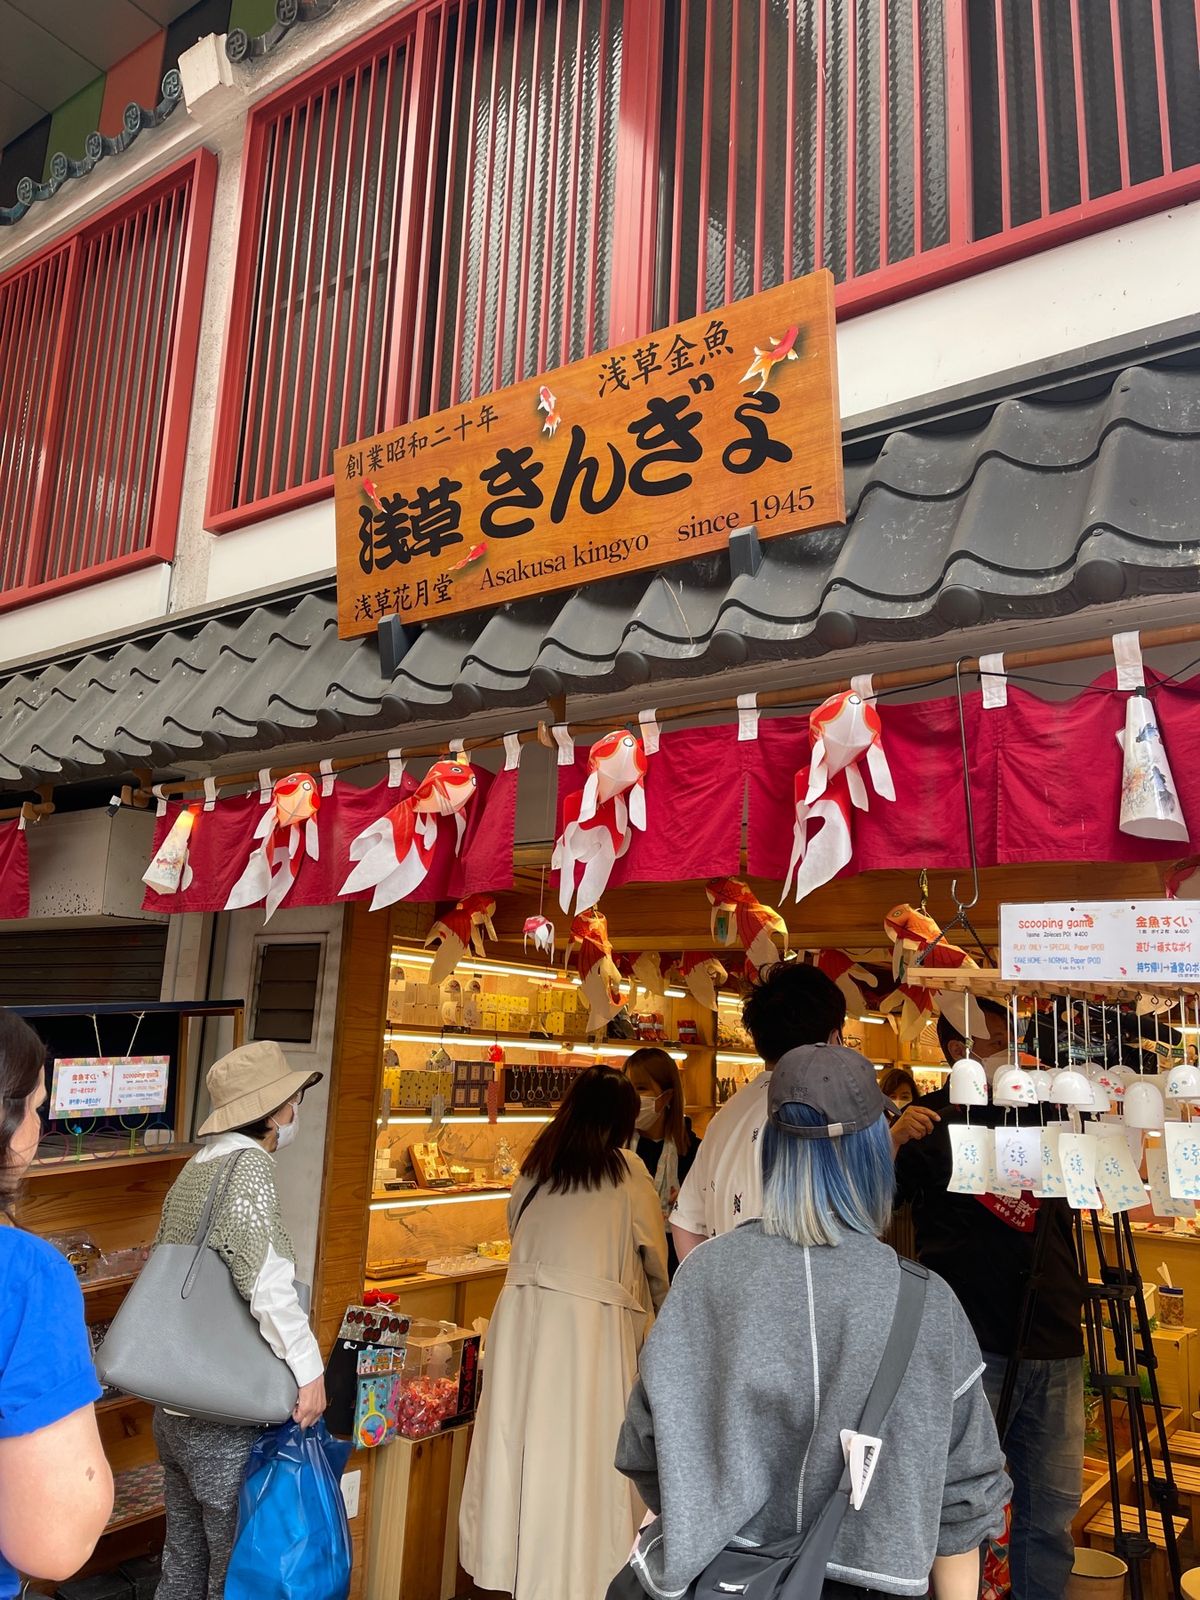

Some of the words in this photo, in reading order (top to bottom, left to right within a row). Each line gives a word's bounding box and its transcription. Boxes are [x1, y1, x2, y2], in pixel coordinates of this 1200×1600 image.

[598, 319, 735, 399] 浅草金魚
[345, 404, 499, 480] 創業昭和二十年
[479, 555, 567, 591] Asakusa
[573, 533, 650, 564] kingyo
[677, 510, 740, 542] since
[750, 485, 815, 524] 1945
[354, 573, 454, 622] 浅草花月堂
[1018, 917, 1064, 930] scooping
[1066, 919, 1095, 930] game
[1136, 915, 1193, 929] 金魚すくい
